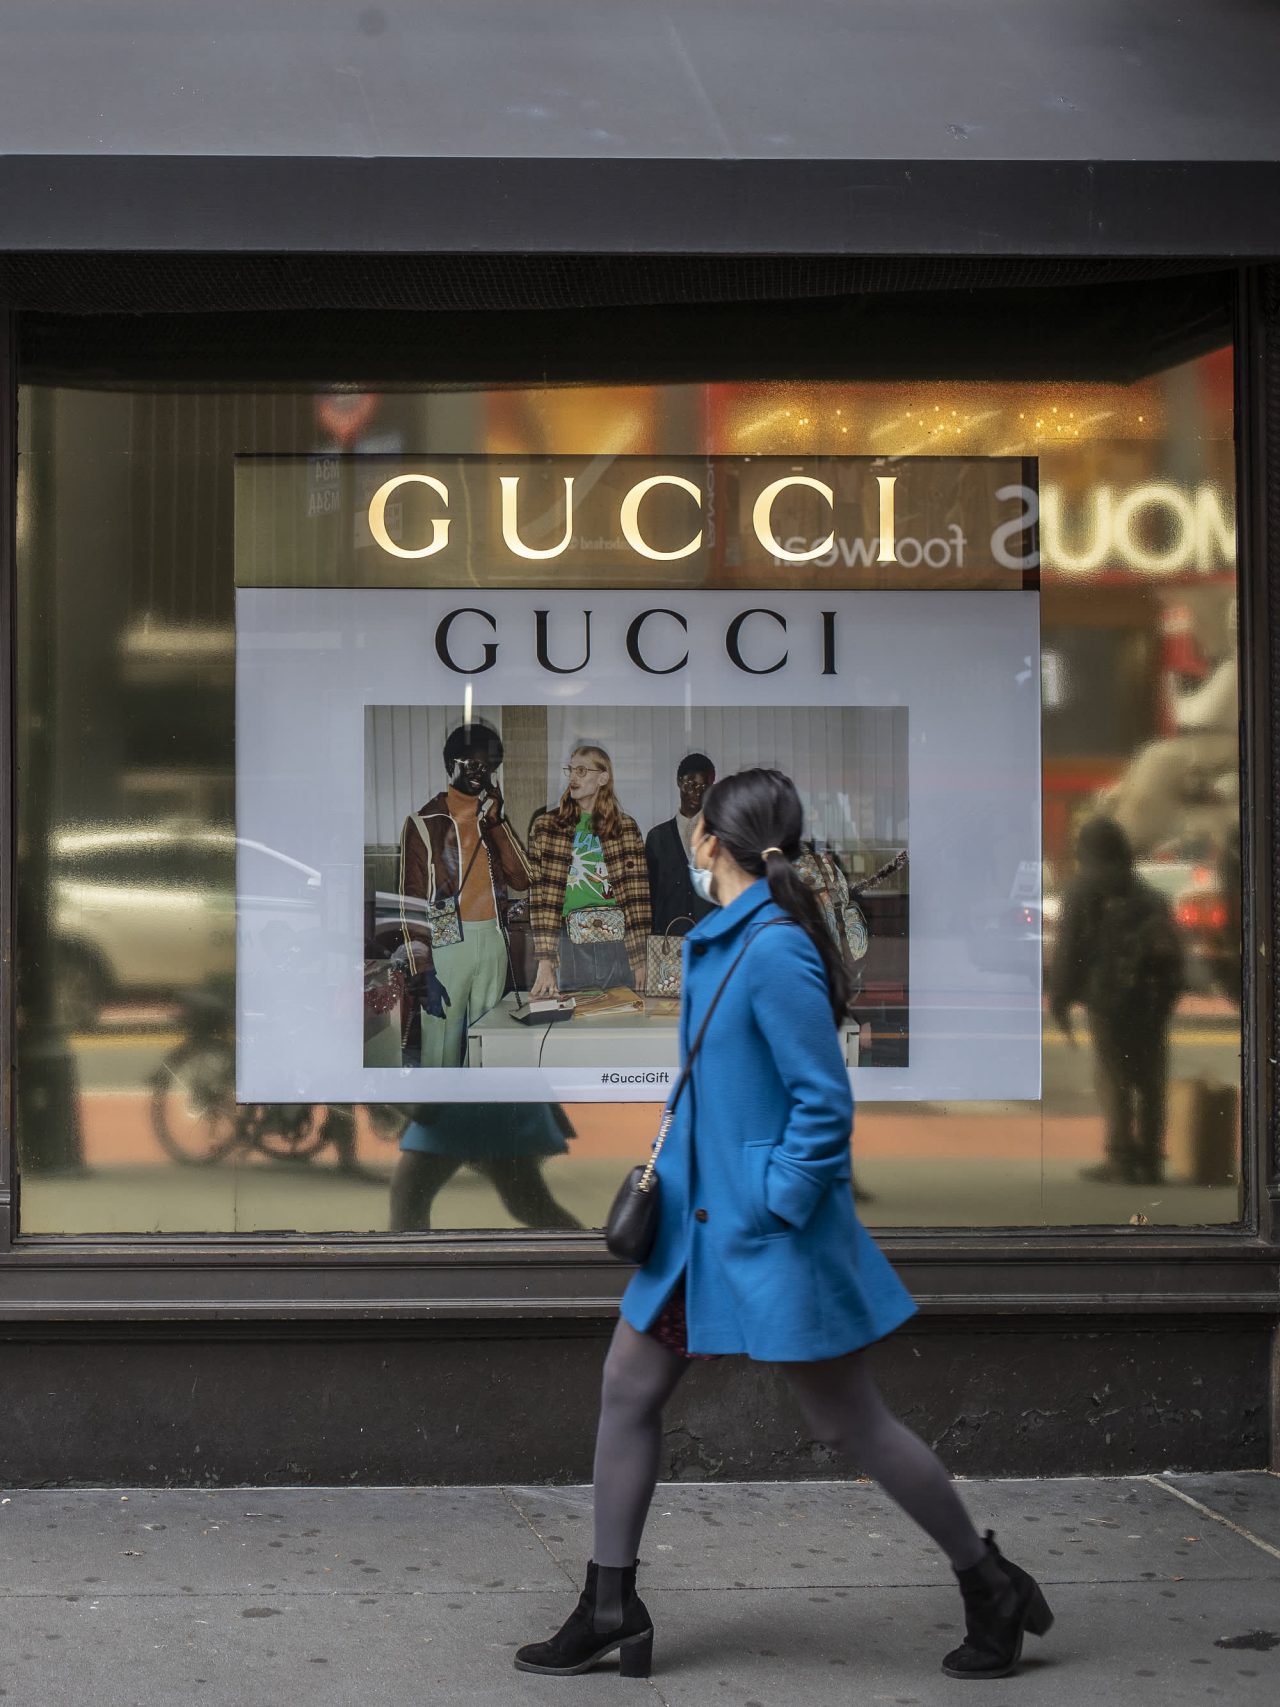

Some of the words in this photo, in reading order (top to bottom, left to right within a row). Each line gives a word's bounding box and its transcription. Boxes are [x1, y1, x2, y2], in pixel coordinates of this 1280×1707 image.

[368, 474, 898, 562] GUCCI
[435, 608, 838, 675] GUCCI
[601, 1072, 669, 1084] #GucciGift
